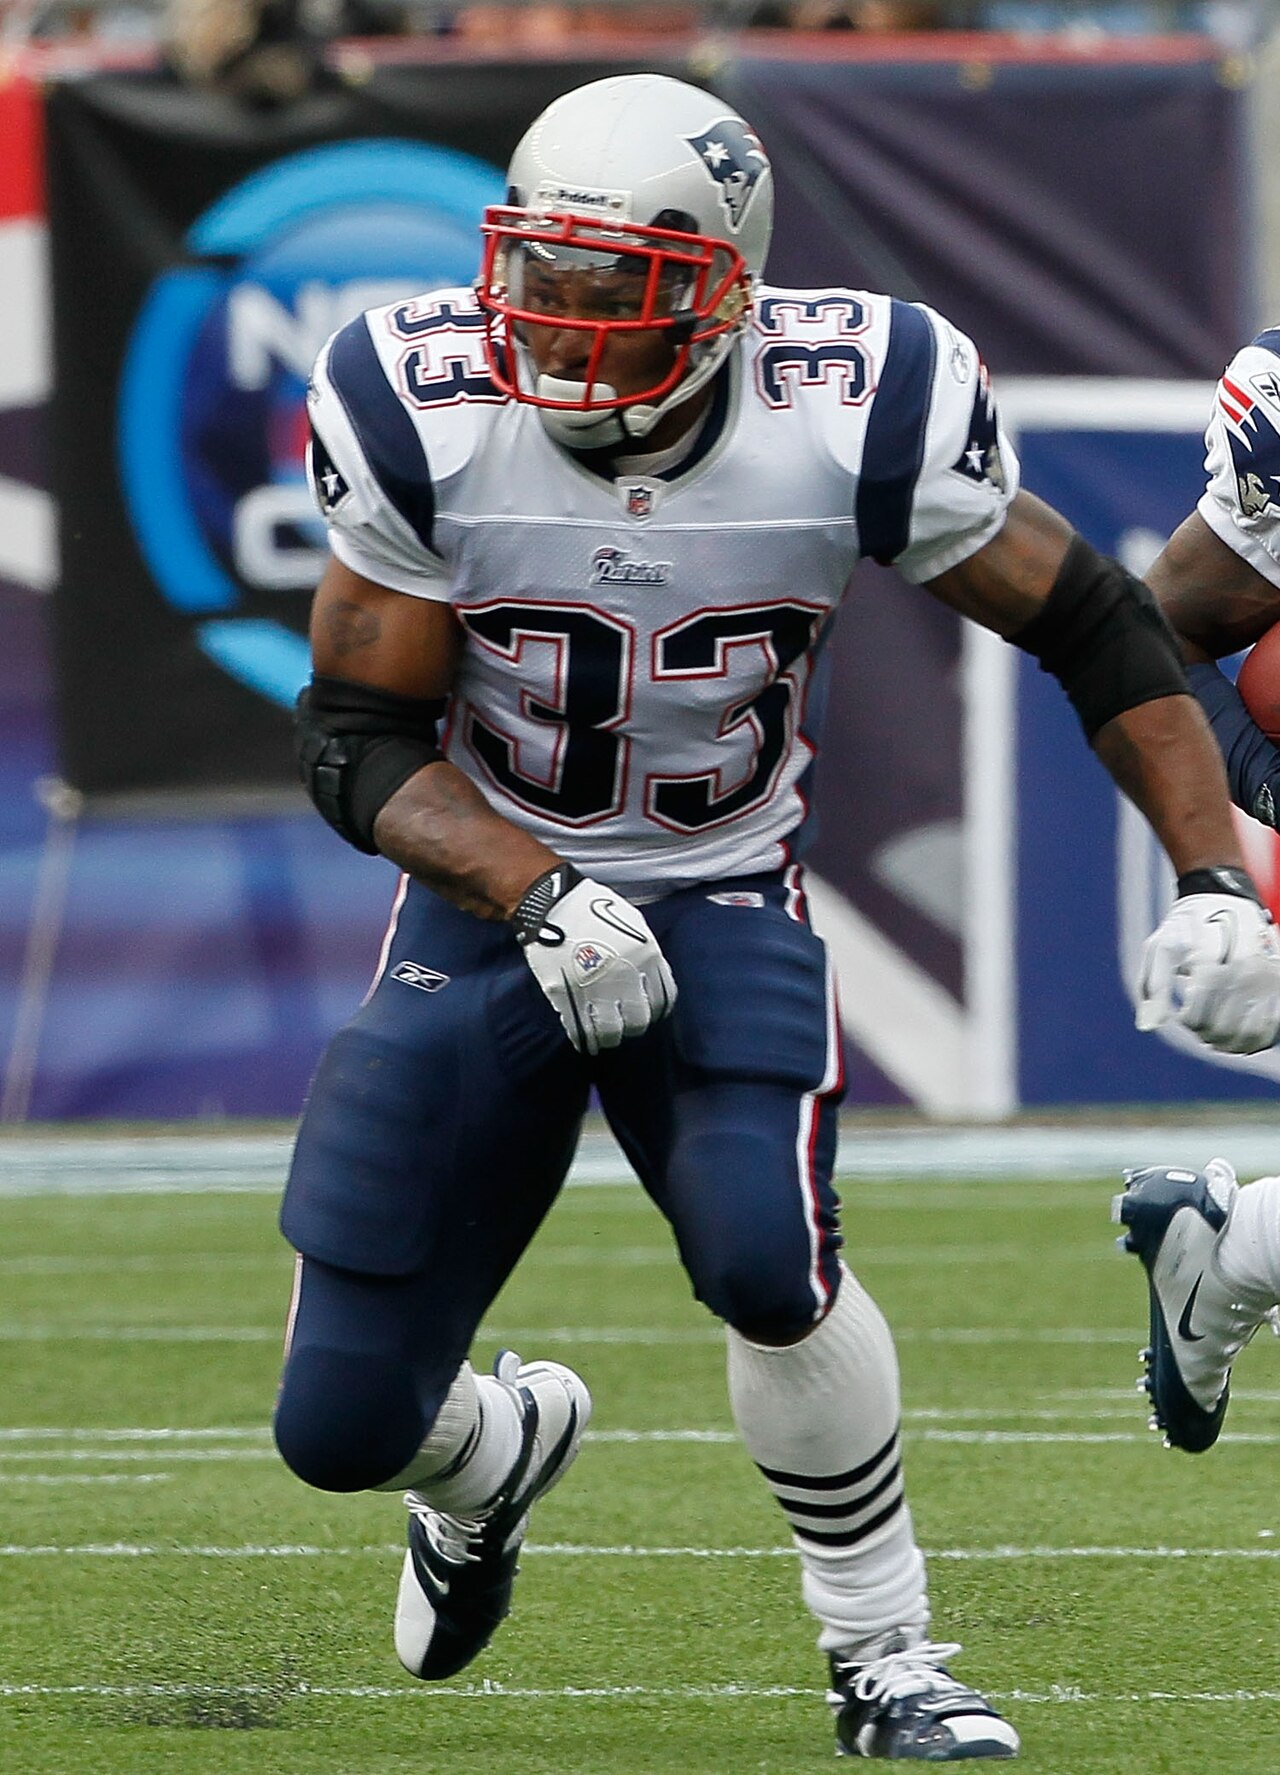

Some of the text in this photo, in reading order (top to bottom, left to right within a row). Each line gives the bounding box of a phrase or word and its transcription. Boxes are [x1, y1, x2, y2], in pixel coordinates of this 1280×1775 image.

[386, 294, 512, 411] 33
[752, 294, 877, 410] 33
[452, 597, 830, 836] 33
